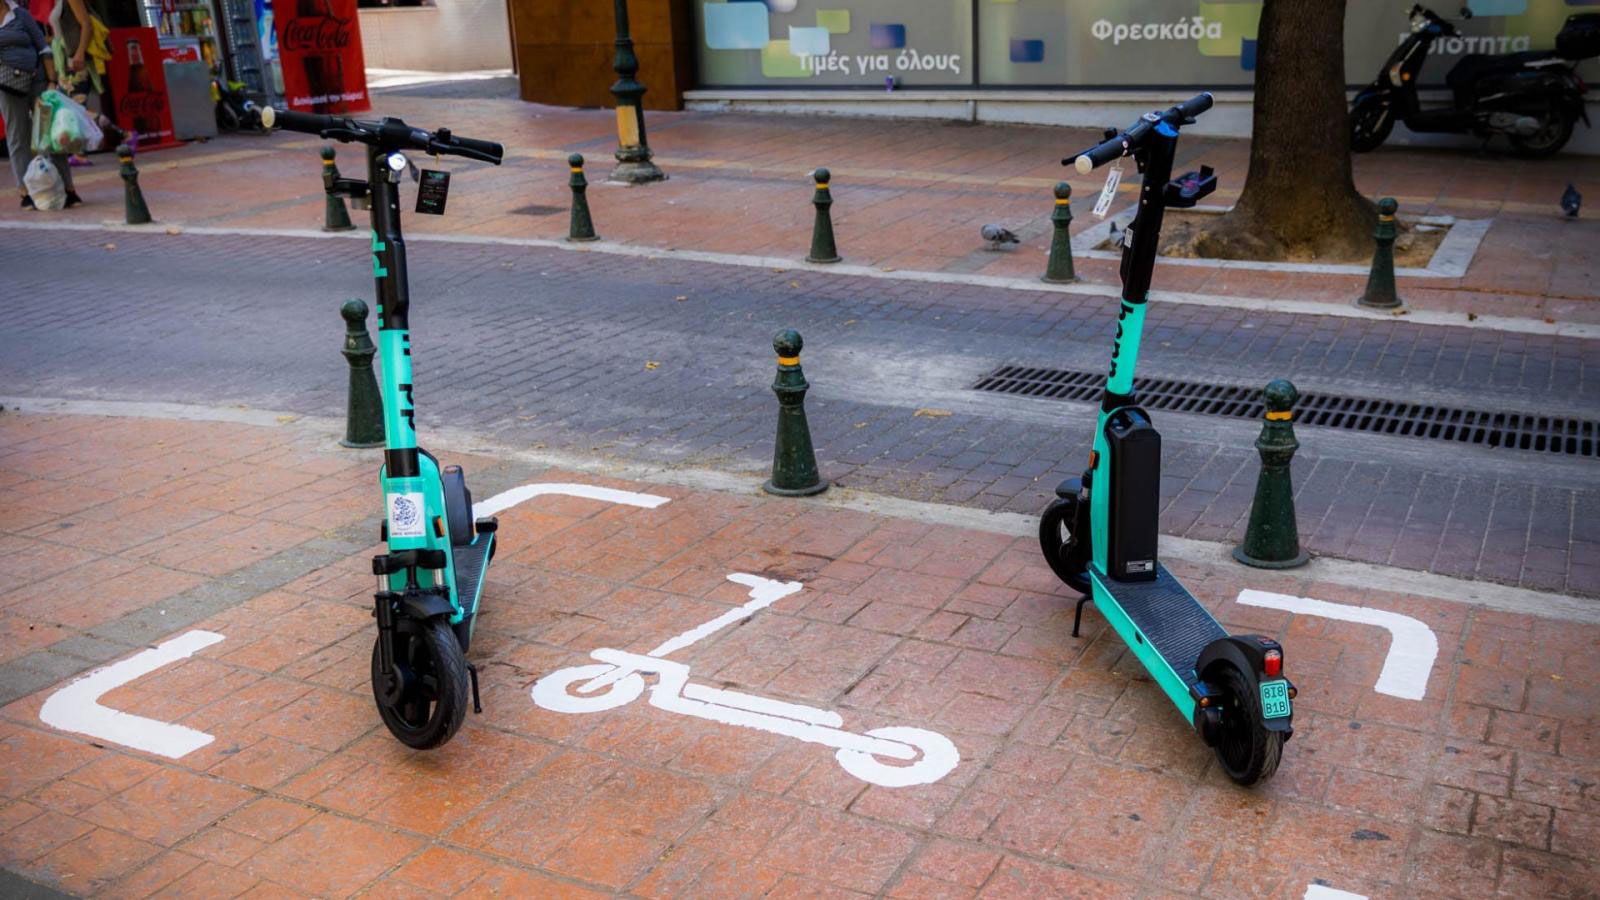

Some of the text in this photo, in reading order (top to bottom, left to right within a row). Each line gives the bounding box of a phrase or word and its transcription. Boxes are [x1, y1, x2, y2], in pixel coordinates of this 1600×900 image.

[1091, 16, 1222, 45] Φρεσκάδα
[797, 49, 960, 75] Τιμές για όλους
